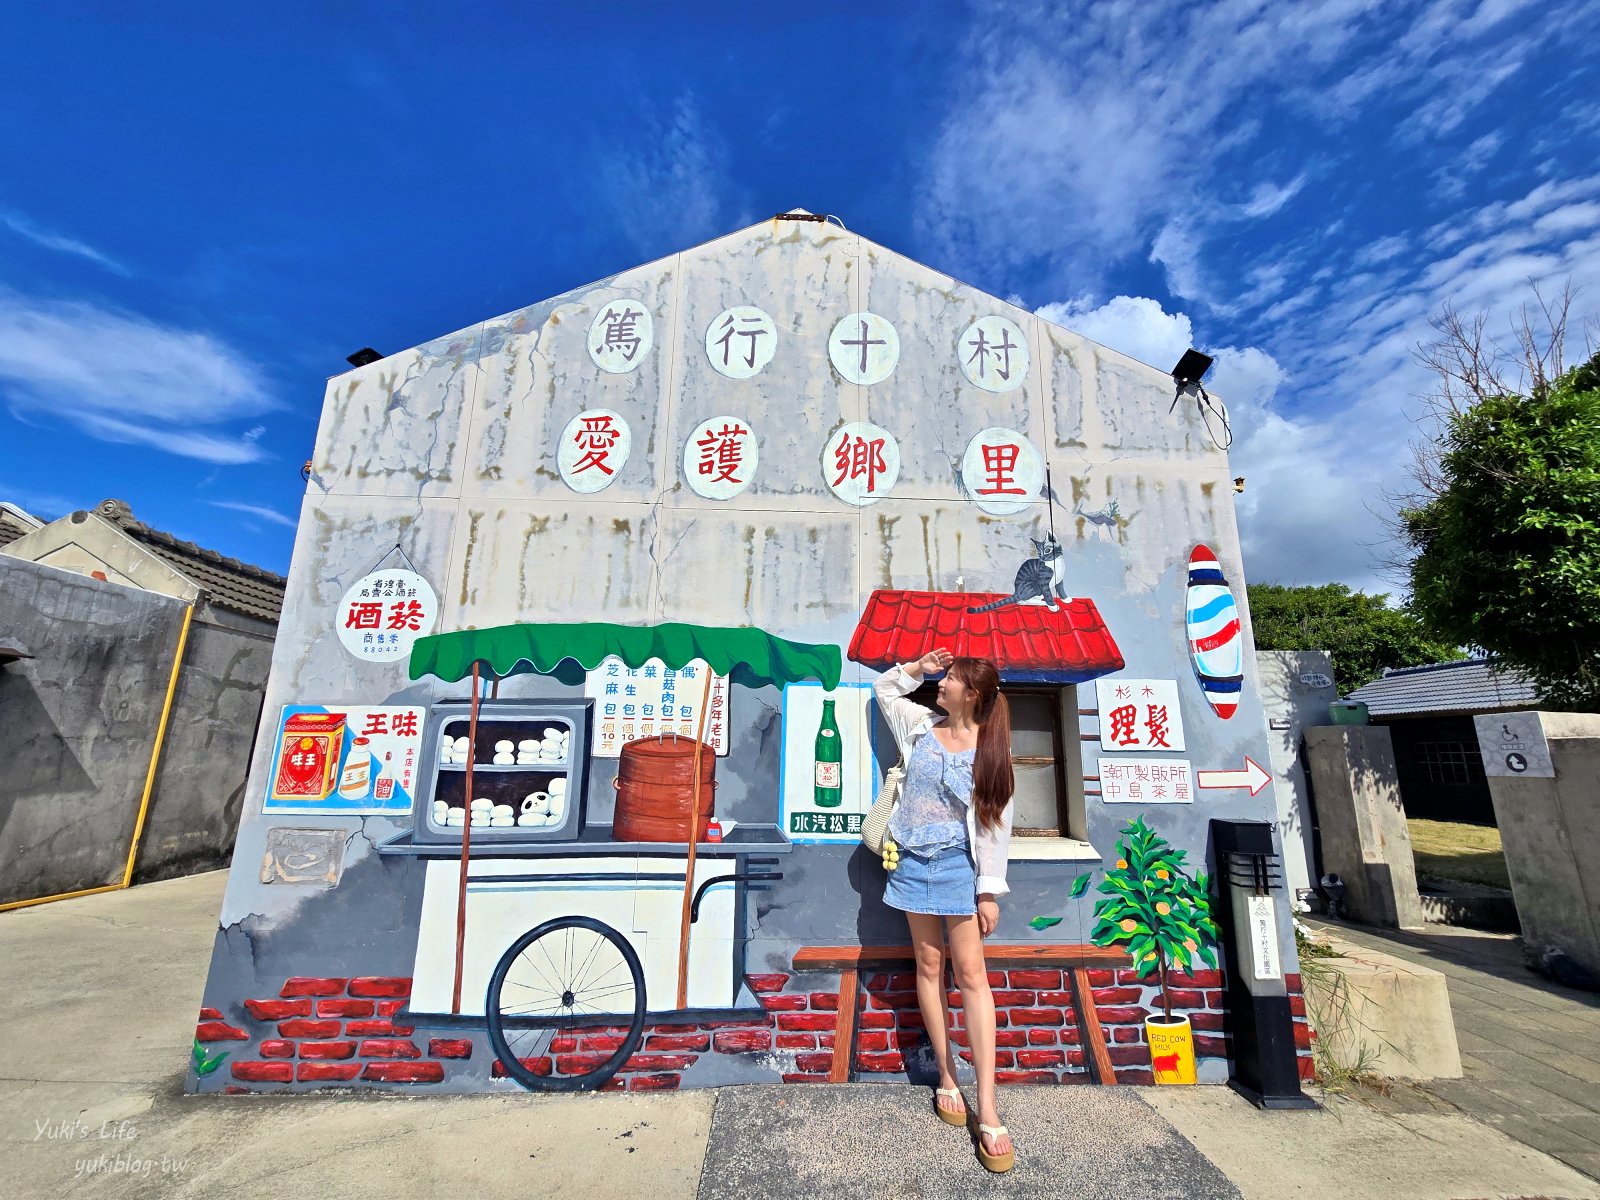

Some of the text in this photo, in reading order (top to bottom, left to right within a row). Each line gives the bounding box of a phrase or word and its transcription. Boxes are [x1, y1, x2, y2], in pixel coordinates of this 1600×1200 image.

[596, 307, 1018, 381] 篤行十村
[571, 415, 1027, 497] 愛護鄉里
[1109, 703, 1171, 748] 理髮
[1106, 782, 1190, 800] 中島茶屋
[1151, 1033, 1186, 1043] RED COW
